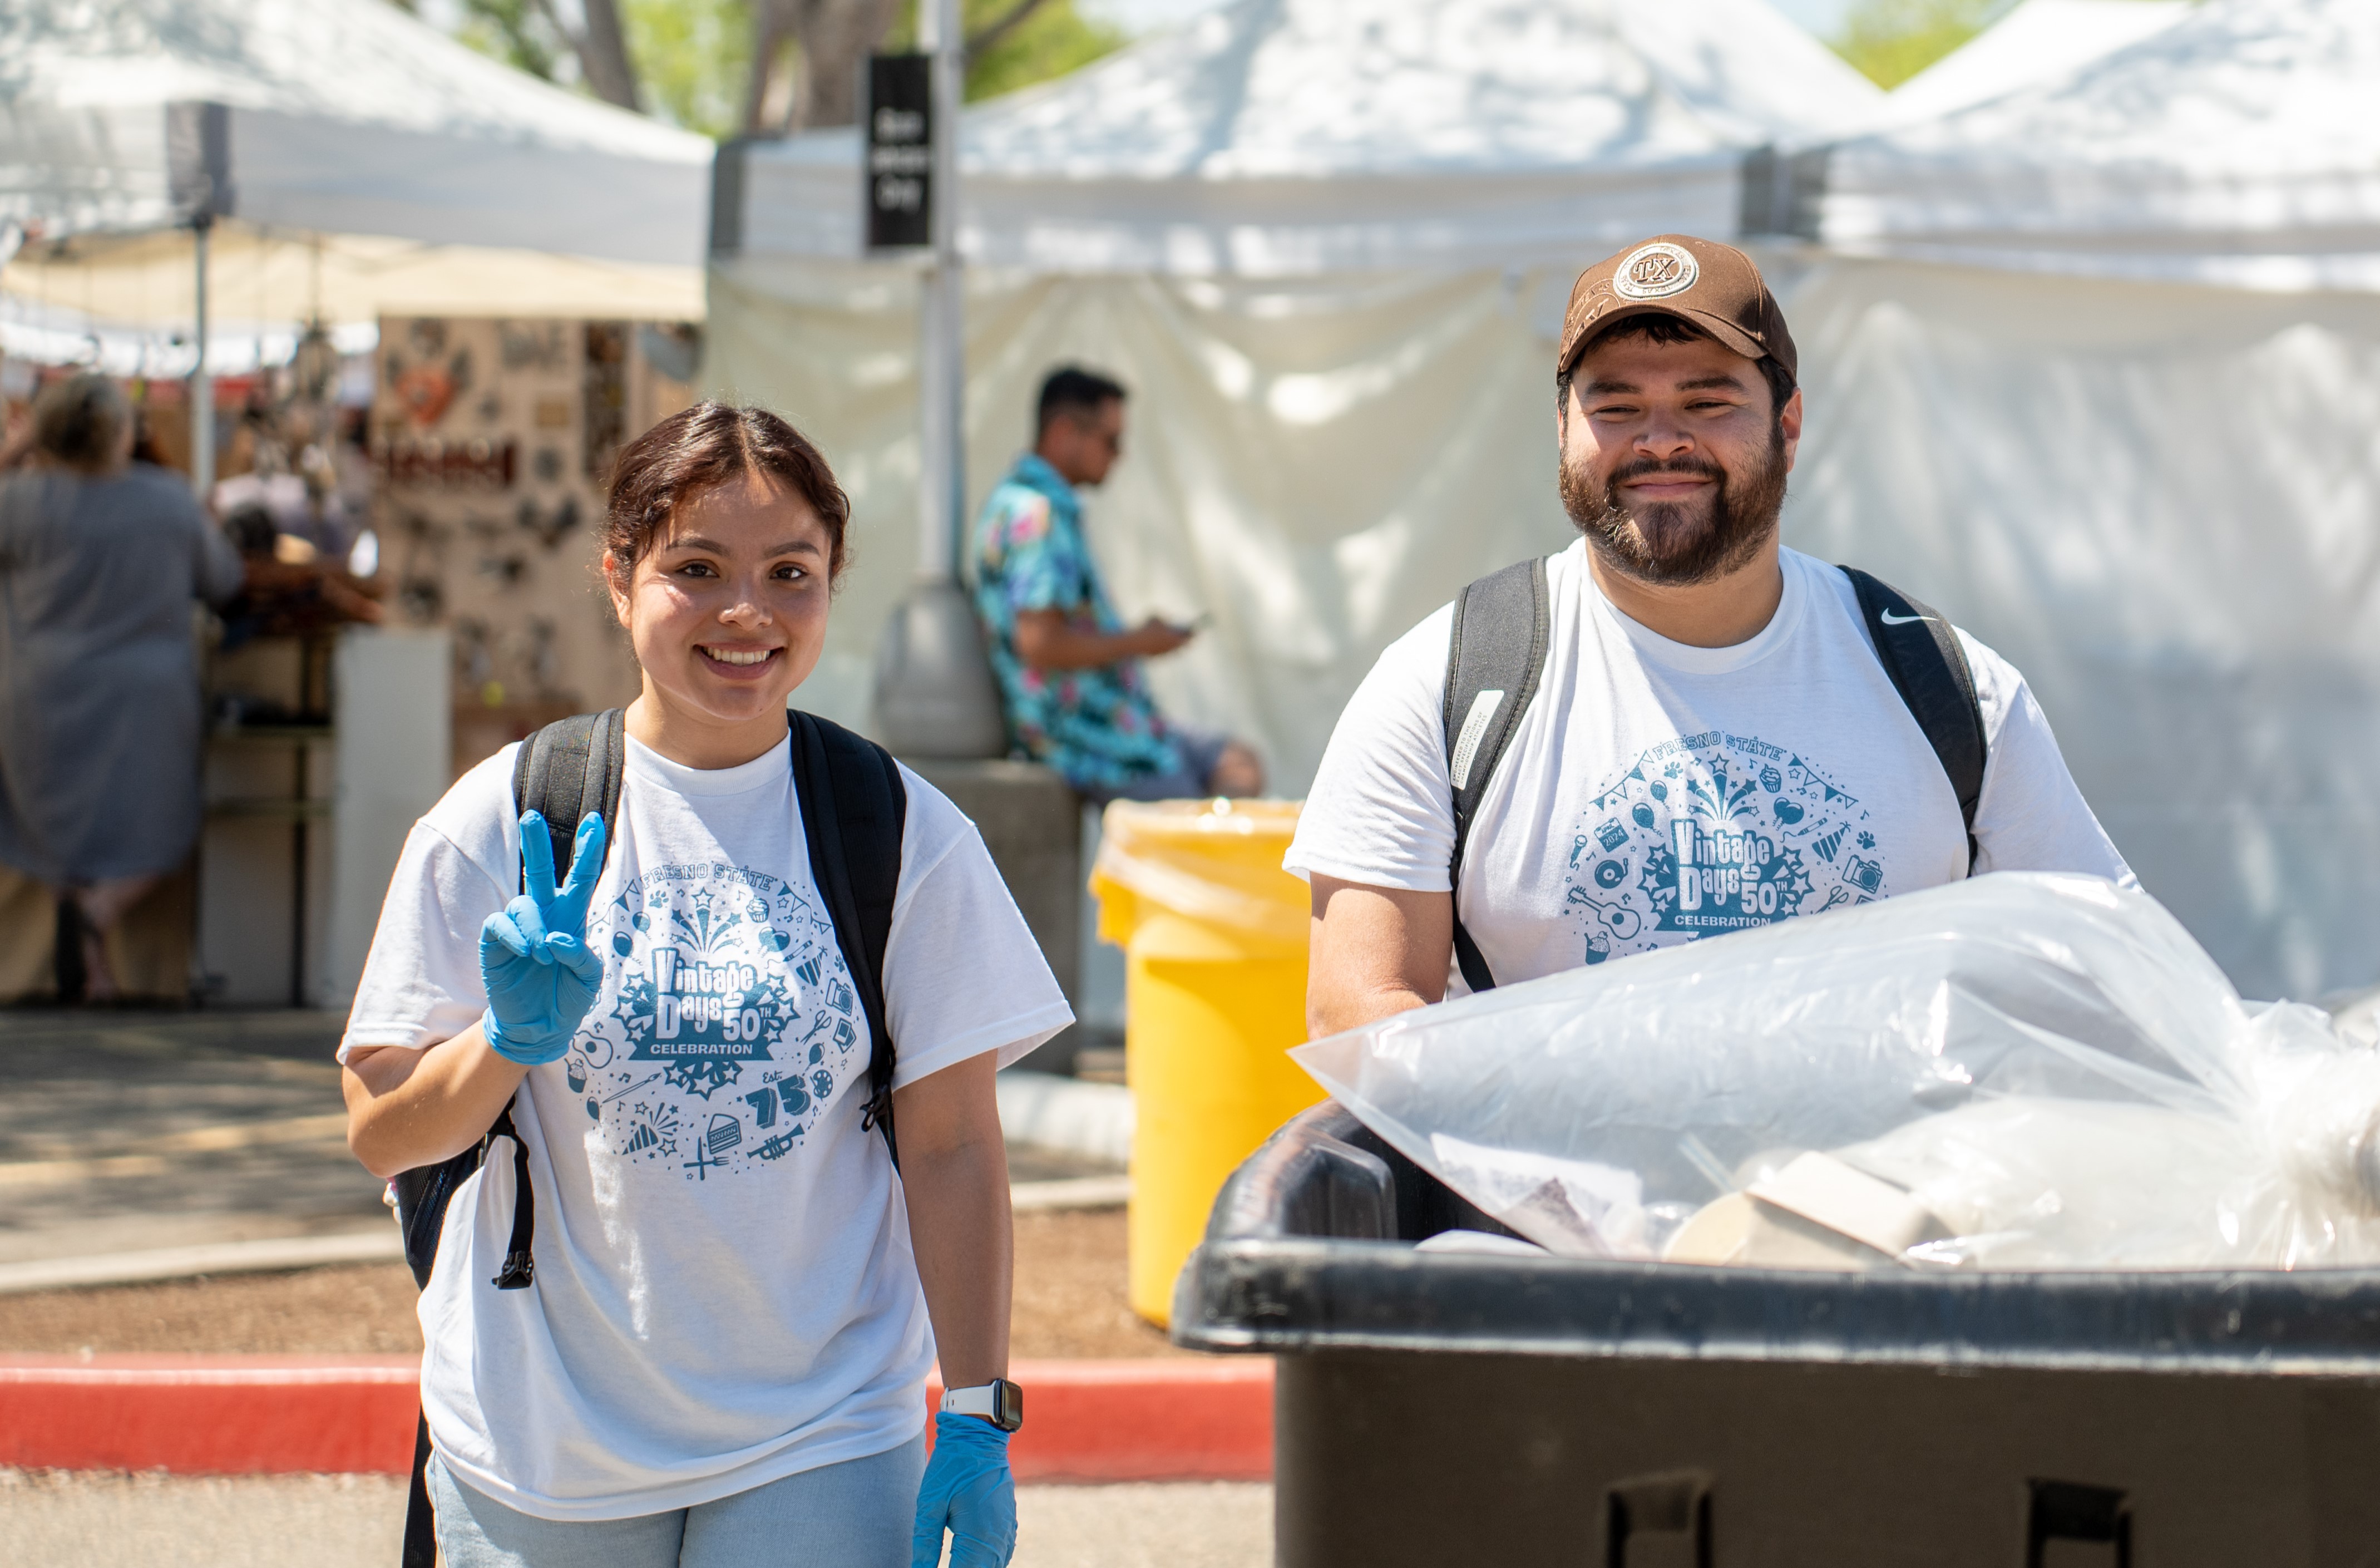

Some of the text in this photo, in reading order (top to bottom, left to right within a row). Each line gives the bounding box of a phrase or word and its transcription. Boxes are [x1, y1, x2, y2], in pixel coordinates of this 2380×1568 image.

[1634, 257, 1676, 283] TX
[1460, 719, 1479, 763] SPECIFICATIONS
[1460, 715, 1487, 783] CHAMPIONSHIP ATHLETES
[1652, 731, 1784, 761] FRESNO STATE
[1453, 746, 1463, 781] ENGINEERED
[1603, 829, 1624, 846] 2024
[1674, 821, 1770, 880] Vintage
[640, 864, 775, 891] FRESNO STATE
[1679, 866, 1740, 910] Days
[1674, 915, 1771, 927] CELEBRATION
[655, 949, 754, 1008] Vintage
[655, 994, 723, 1039] Days
[650, 1044, 753, 1054] CELEBRATION
[762, 1070, 783, 1084] Est.
[745, 1074, 811, 1130] 75
